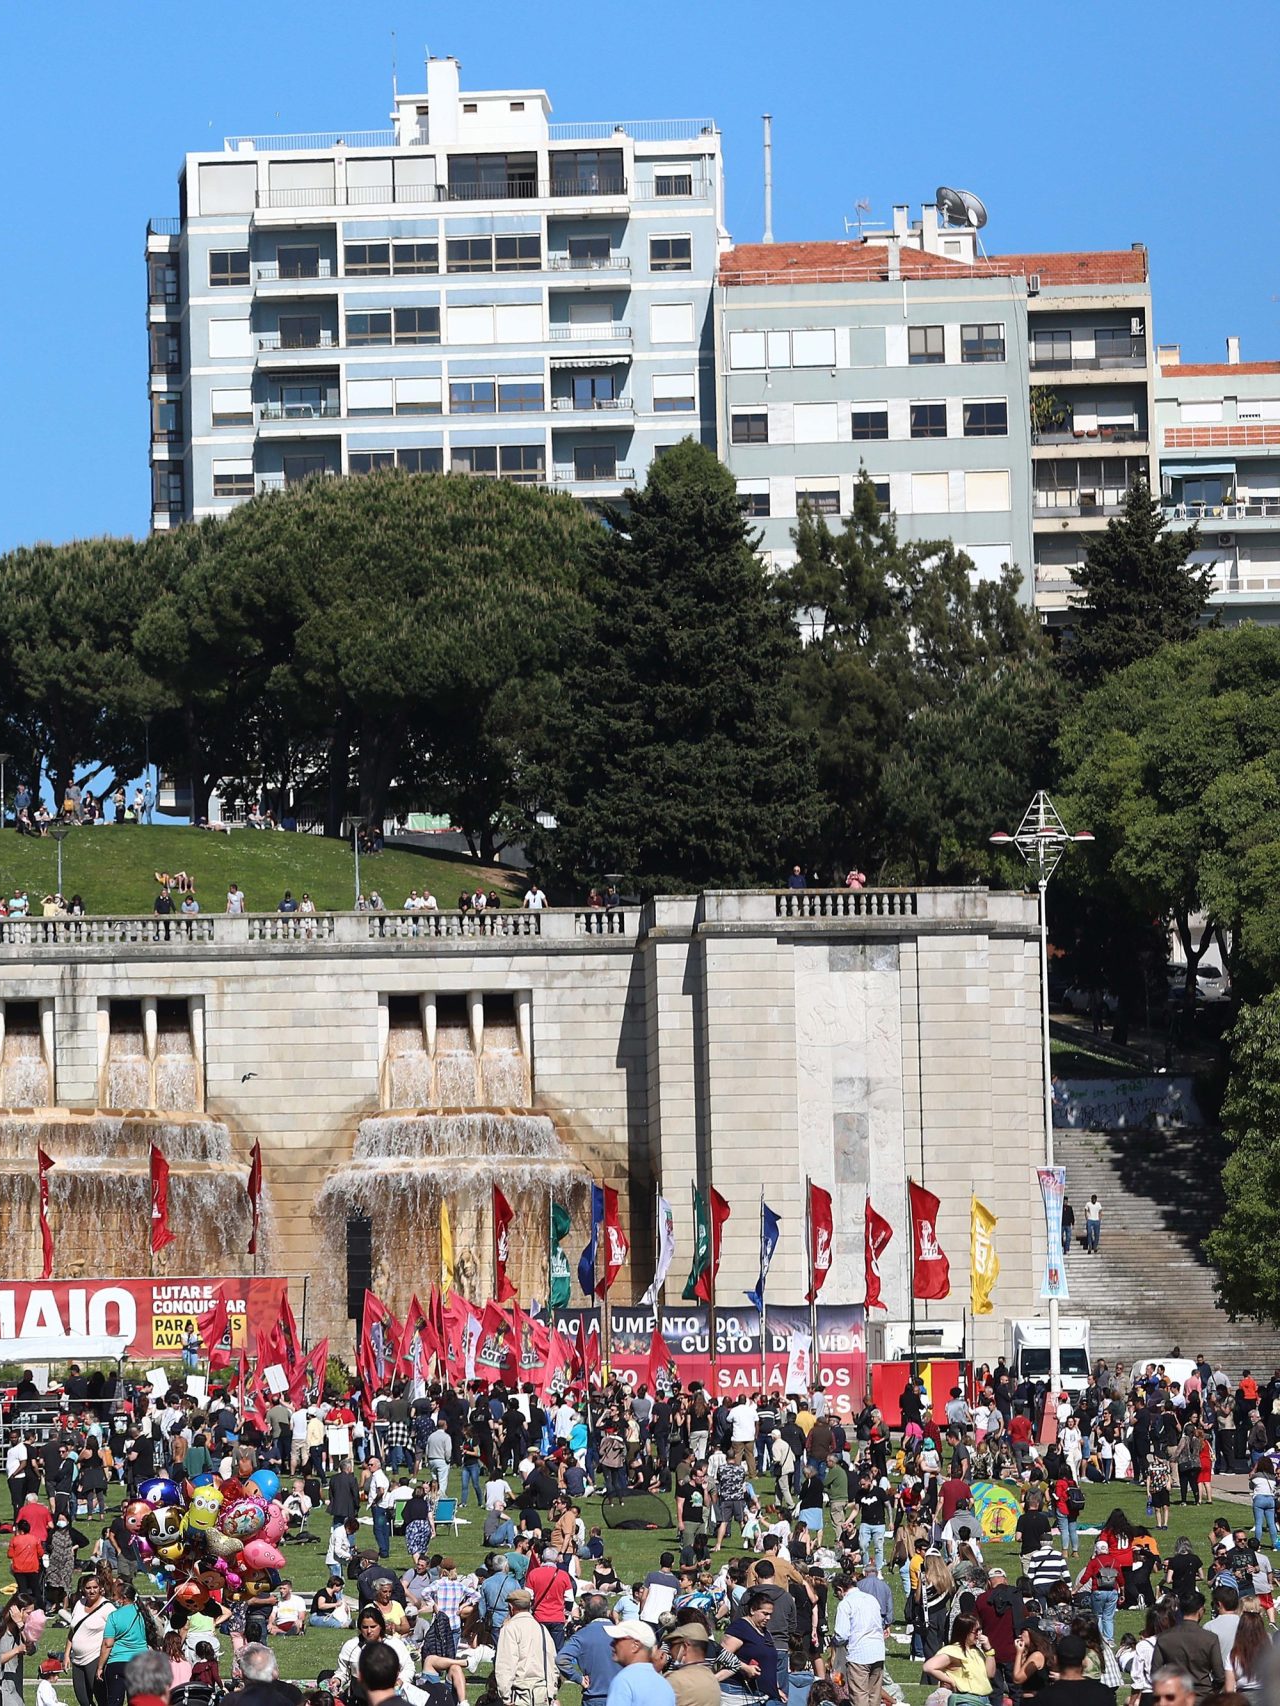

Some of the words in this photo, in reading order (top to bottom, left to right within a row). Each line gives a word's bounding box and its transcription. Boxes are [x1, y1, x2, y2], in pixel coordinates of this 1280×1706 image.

[153, 1286, 199, 1299] LUTAR
[203, 1286, 212, 1298] E
[588, 1316, 699, 1335] AUMENTO
[716, 1317, 739, 1333] DO
[681, 1335, 753, 1353] CUSTO
[819, 1334, 862, 1351] VIDA
[481, 1347, 507, 1362] CGTP
[1117, 1538, 1129, 1549] 10
